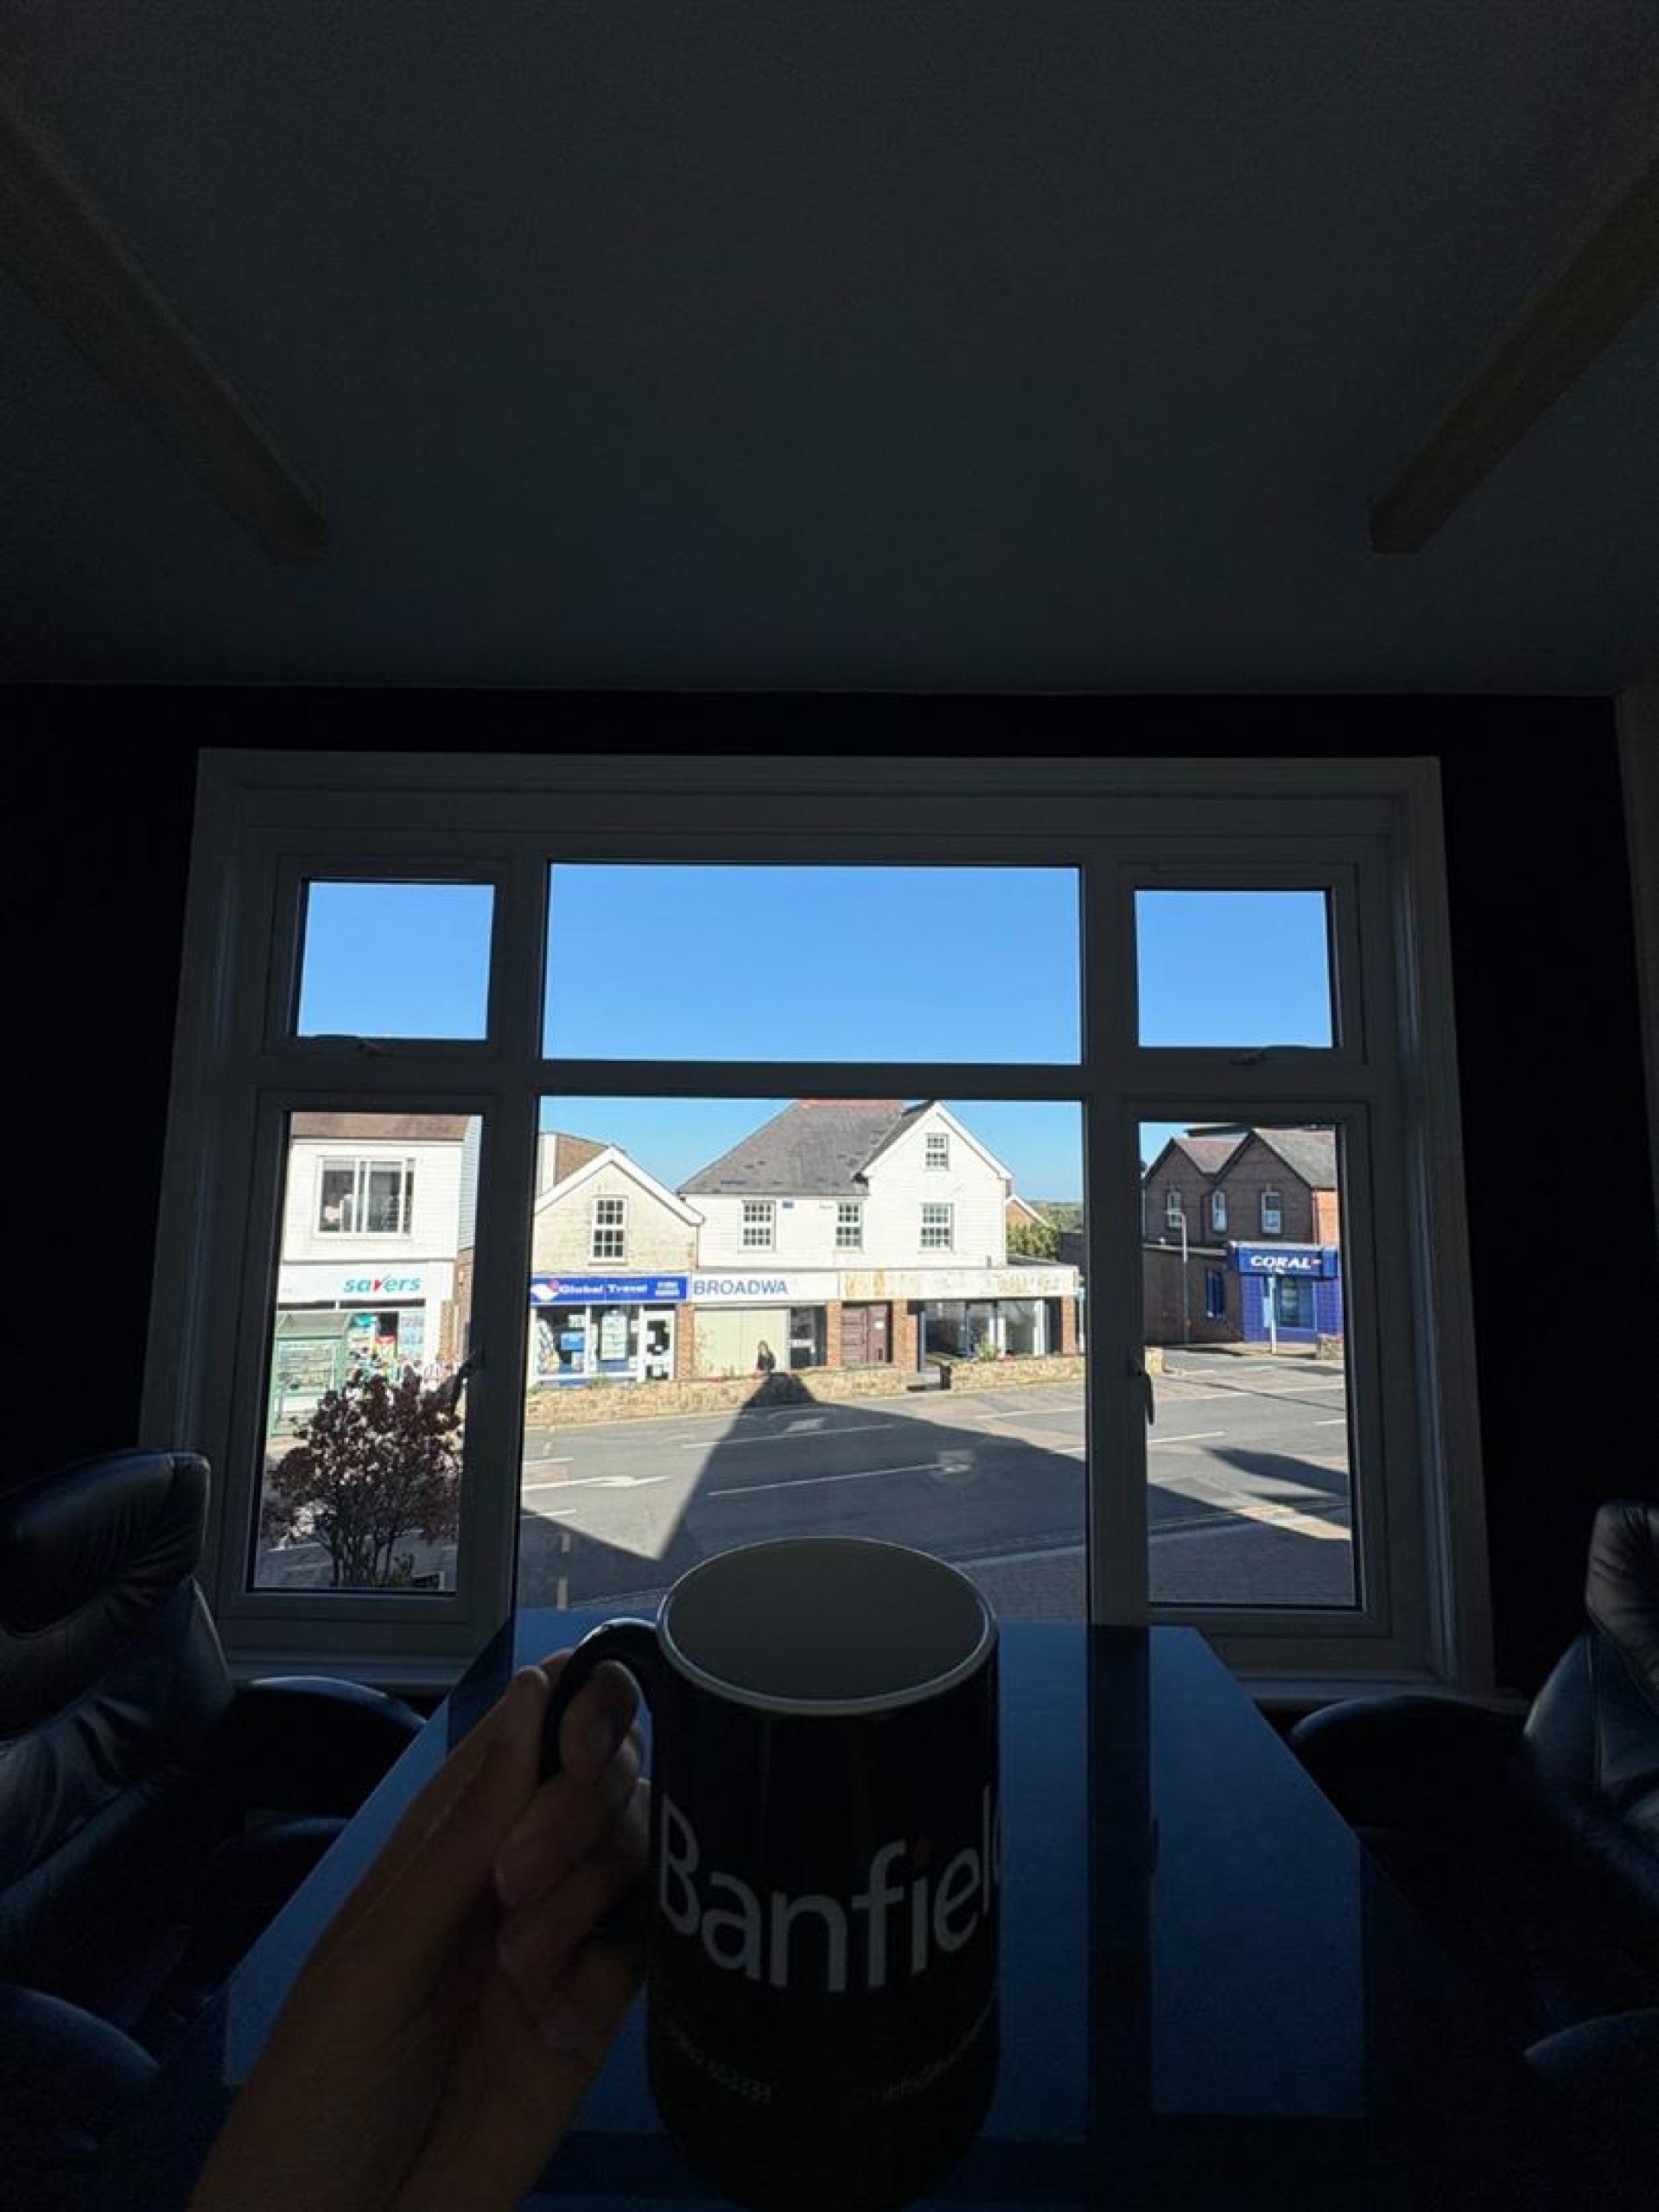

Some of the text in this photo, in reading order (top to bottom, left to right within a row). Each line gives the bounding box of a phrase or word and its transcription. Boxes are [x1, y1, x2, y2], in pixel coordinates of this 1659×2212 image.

[1249, 1255, 1312, 1269] CORAL
[343, 1275, 422, 1294] savers
[693, 1279, 789, 1295] BROADWA
